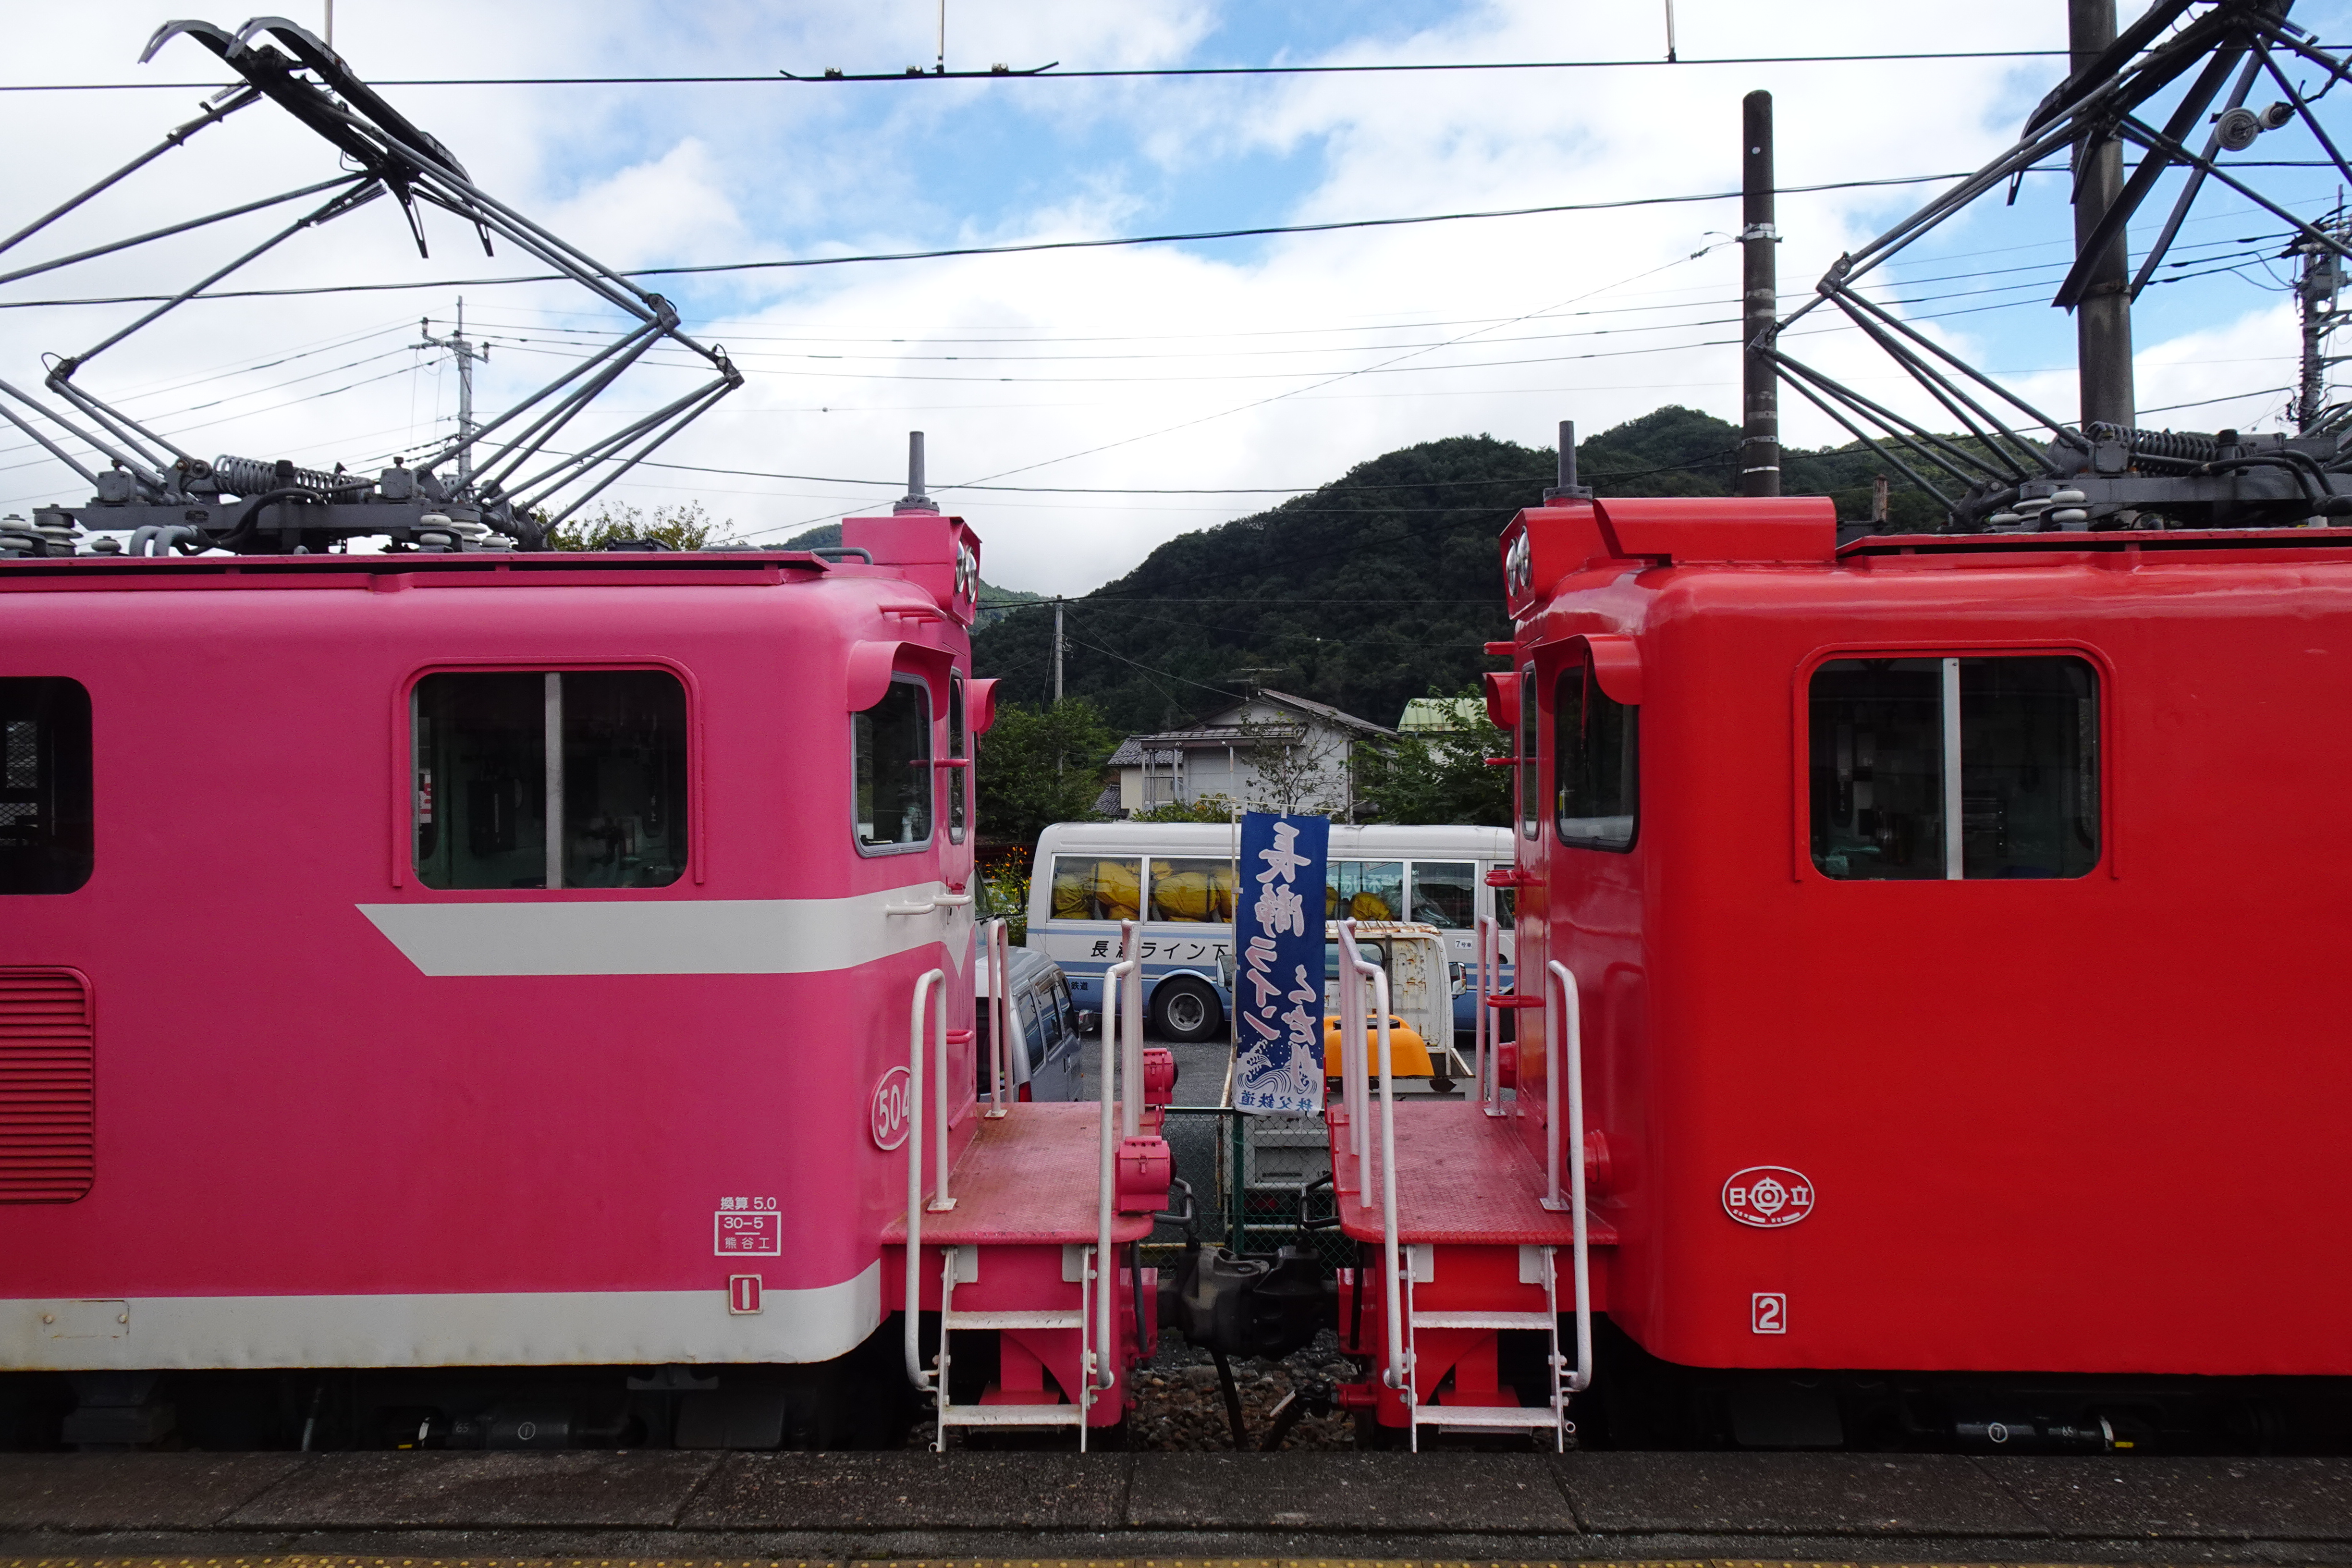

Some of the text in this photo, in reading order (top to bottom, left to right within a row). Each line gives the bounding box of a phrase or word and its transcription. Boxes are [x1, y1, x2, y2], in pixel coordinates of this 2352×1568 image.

[879, 1078, 910, 1138] 504
[721, 1197, 776, 1210] 換算 5.0
[724, 1217, 763, 1229] 30-5
[725, 1237, 770, 1249] 熊谷工
[1759, 1298, 1779, 1329] 2
